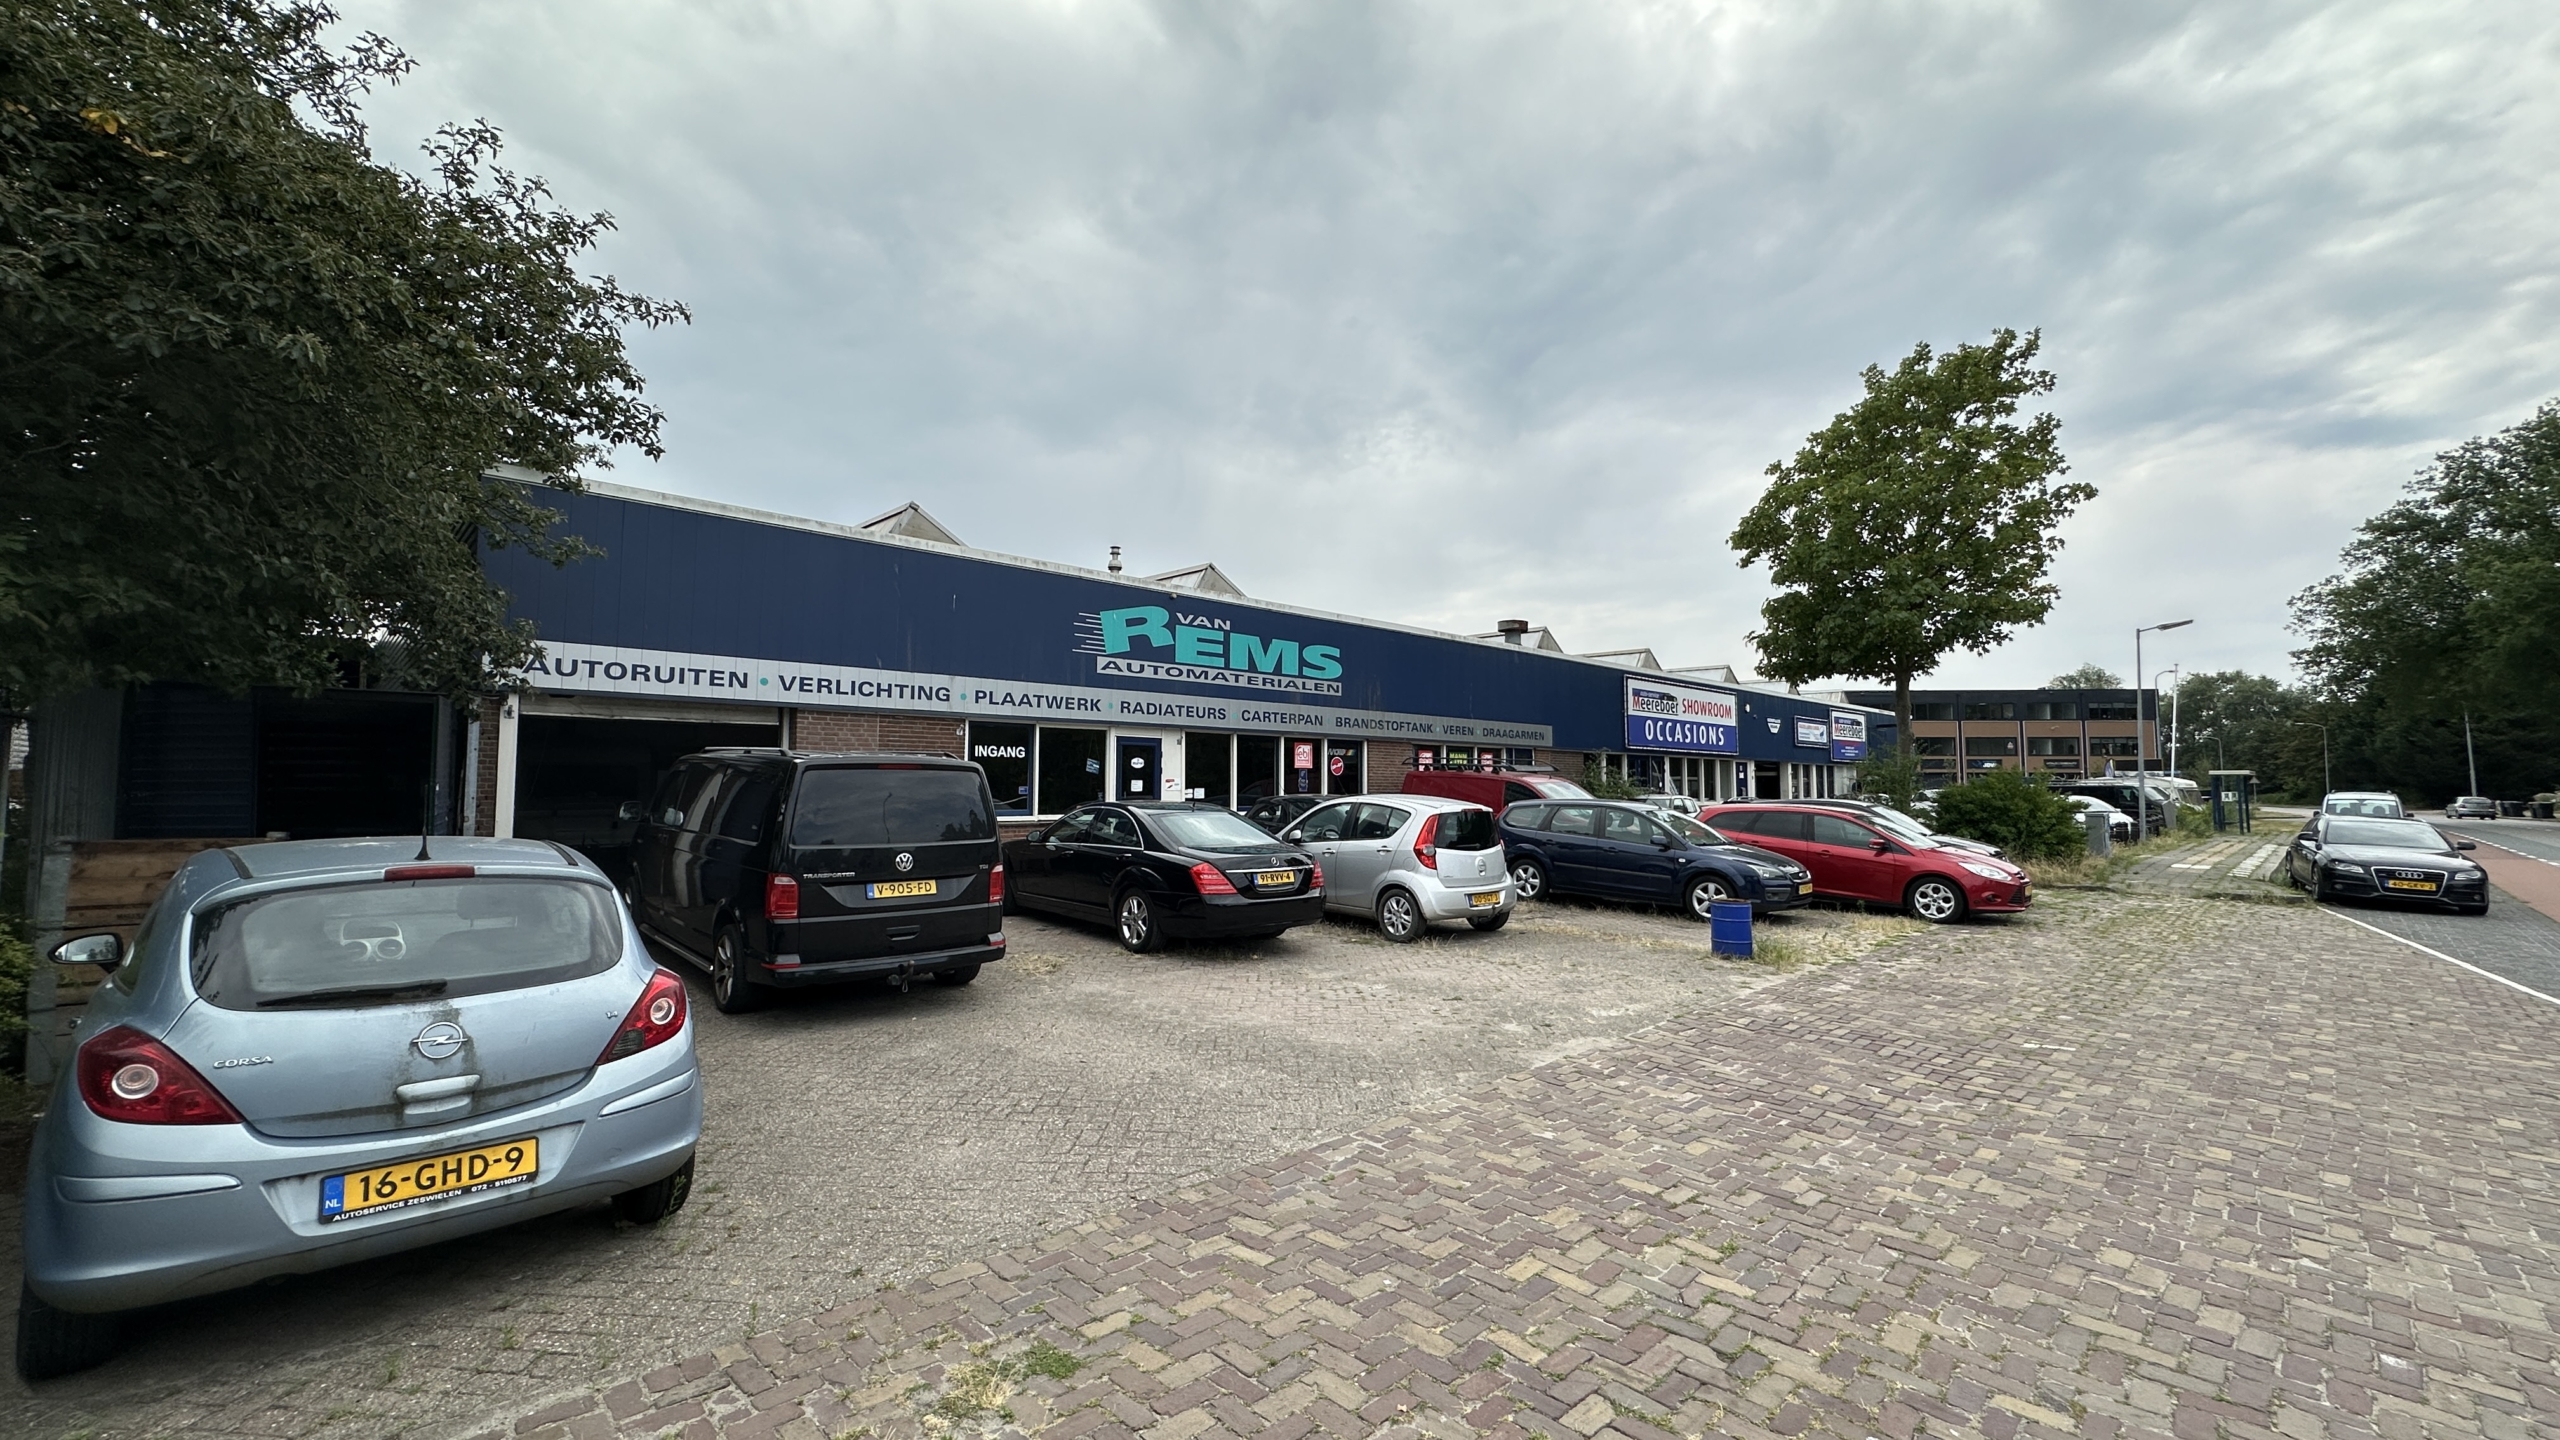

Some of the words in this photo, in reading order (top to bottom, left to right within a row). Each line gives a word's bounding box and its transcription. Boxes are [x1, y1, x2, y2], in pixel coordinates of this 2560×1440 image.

[1175, 612, 1231, 631] VAN
[1099, 605, 1342, 680] REMS
[1099, 661, 1341, 694] AUTOMATERIALEN
[521, 655, 749, 689] AUTORUITEN
[778, 674, 952, 702] VERLICHTING
[974, 689, 1102, 713] PLAATWERK
[1119, 700, 1227, 721] RADIATEURS
[1240, 709, 1324, 727] CARTERPAN
[1334, 716, 1433, 734] BRANDSTOFTANK
[1441, 724, 1475, 737] VEREN
[1482, 727, 1545, 741] DRAAGARMEN
[1631, 695, 1679, 714] Meereboer
[1682, 698, 1732, 719] SHOWROOM
[1645, 719, 1725, 746] OCCASIONS
[974, 744, 1026, 758] INGANG
[802, 871, 856, 880] TRANSPORTER
[876, 882, 932, 896] V-905-FD
[213, 1055, 273, 1070] CORSA
[360, 1146, 525, 1203] 16-GHD-9
[325, 1199, 341, 1209] NL
[332, 1200, 406, 1222] AUTOSERVICE
[407, 1189, 462, 1206] ZESWIELEN
[471, 1184, 488, 1192] 072
[494, 1175, 528, 1187] 5110577
